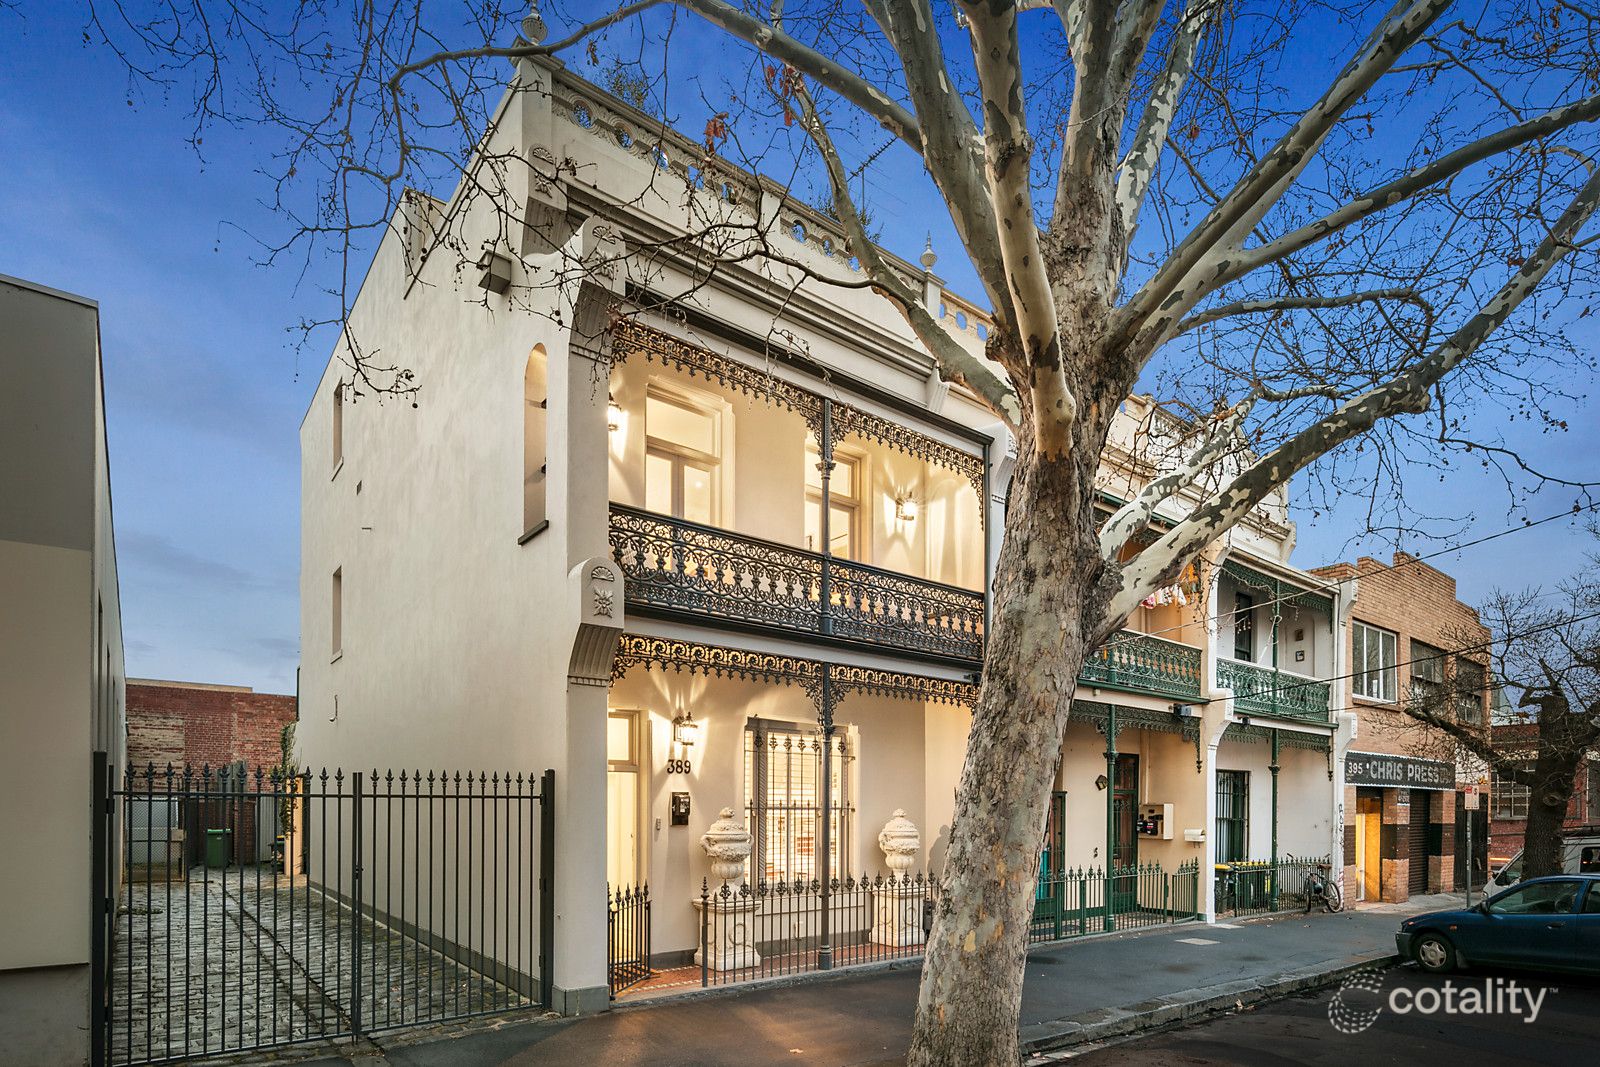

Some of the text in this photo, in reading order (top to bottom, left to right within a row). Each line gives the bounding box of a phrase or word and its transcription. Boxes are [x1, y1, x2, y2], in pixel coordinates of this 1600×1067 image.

[667, 759, 691, 774] 389
[1348, 762, 1363, 774] 395
[1370, 761, 1403, 781] CHRIS
